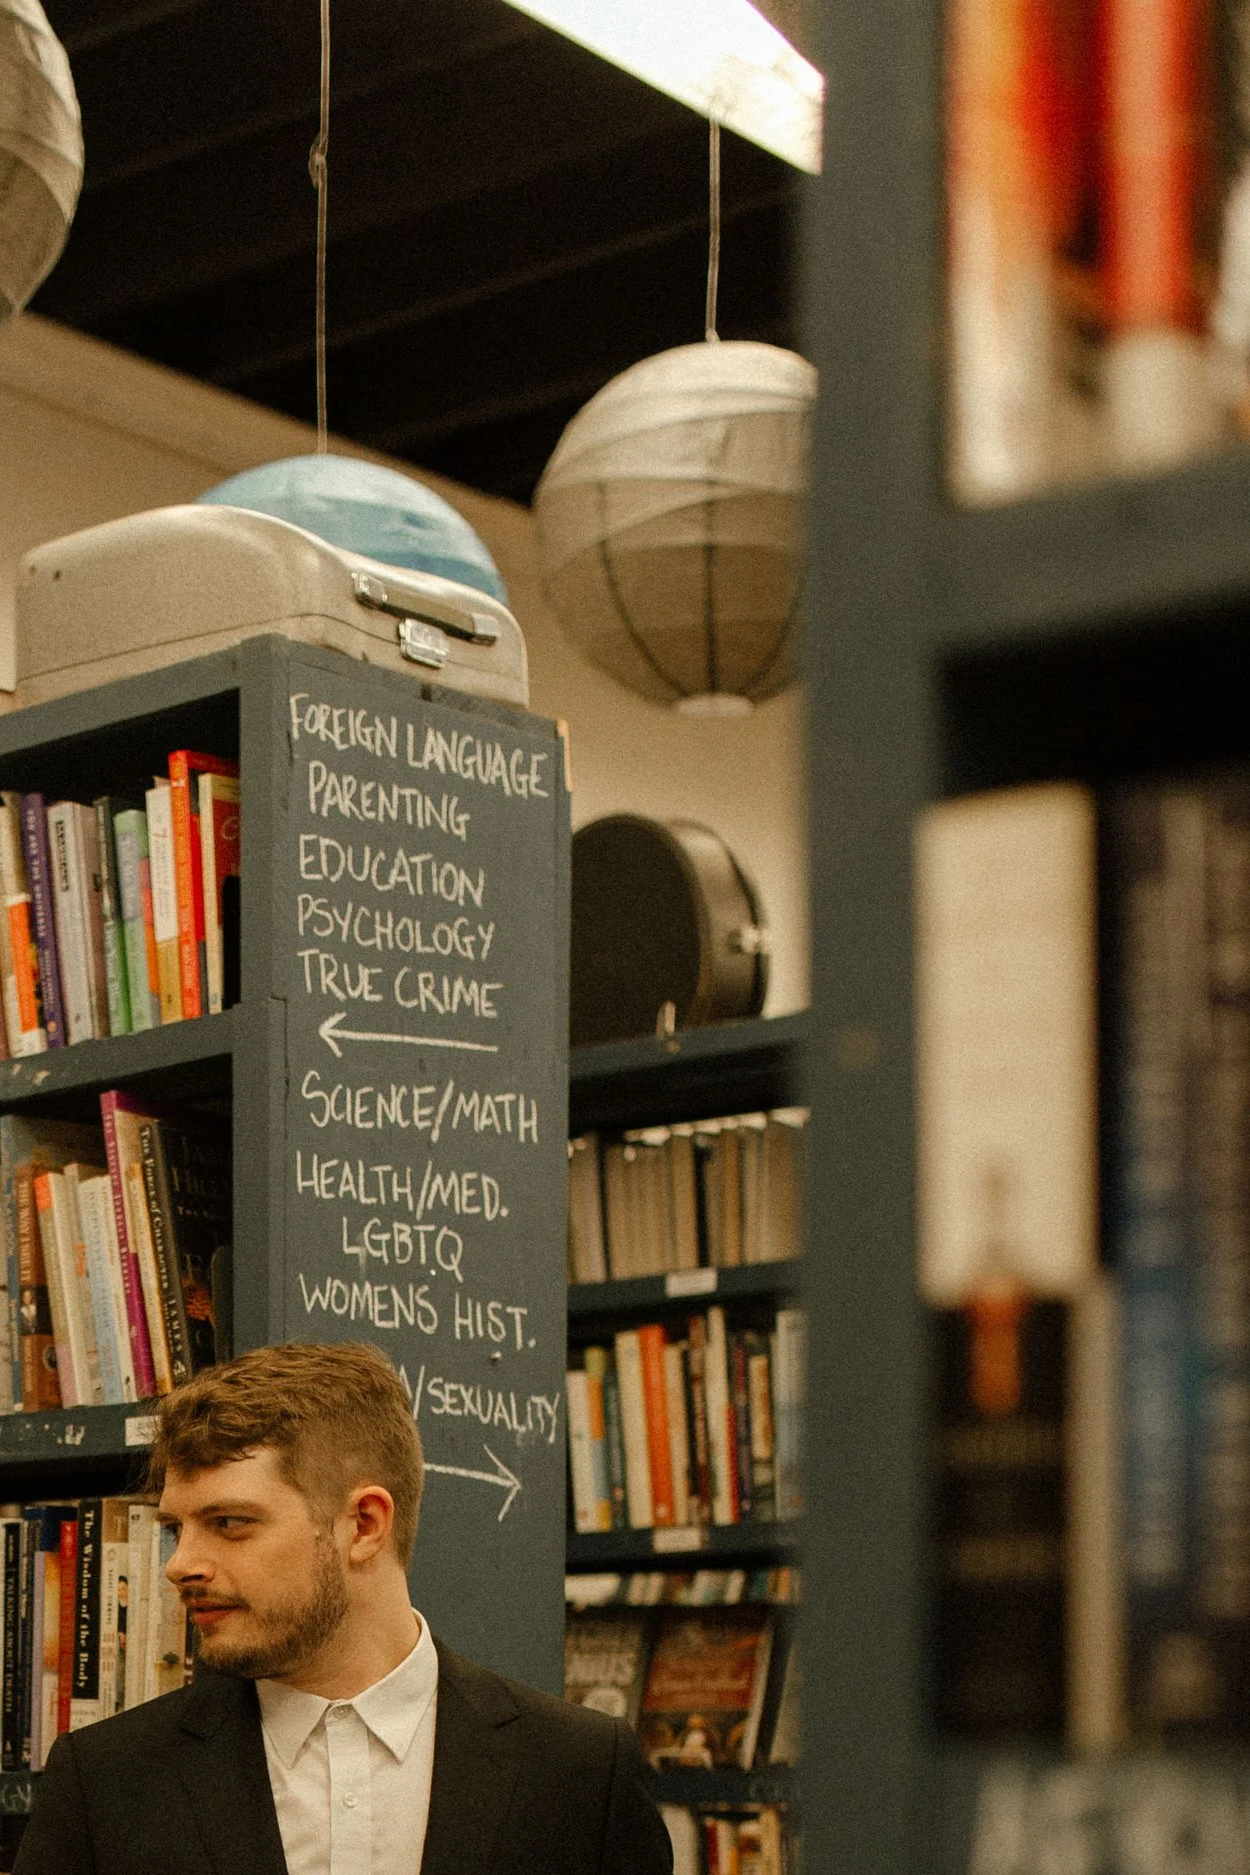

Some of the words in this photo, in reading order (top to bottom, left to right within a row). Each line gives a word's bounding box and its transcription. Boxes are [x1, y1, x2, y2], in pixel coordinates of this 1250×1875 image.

[289, 693, 398, 758] FOREIGN
[406, 723, 549, 798] LANGUAGE
[25, 809, 35, 830] YOU
[308, 761, 471, 841] PARENTING
[28, 834, 38, 855] ARE
[31, 859, 40, 879] THE
[299, 834, 485, 907] EDUCATION
[32, 884, 46, 937] UNIVERSE
[297, 894, 495, 961] PSYCHOLOGY
[297, 949, 383, 1001] TRUE
[394, 967, 504, 1018] CRIME
[302, 1070, 538, 1143] SCIENCE/MATH
[139, 1127, 153, 1155] THE
[18, 1181, 28, 1206] THE
[143, 1157, 158, 1197] FORCE
[19, 1208, 29, 1235] WAY
[149, 1199, 161, 1215] of
[20, 1242, 29, 1265] SEE
[152, 1216, 172, 1289] CHARACTER
[342, 1217, 463, 1282] LGBTQ
[20, 1268, 29, 1280] IT
[168, 1297, 184, 1352] JAMES
[299, 1273, 438, 1334] WOMENS
[454, 1297, 537, 1349] HIST.
[84, 1510, 93, 1538] The
[81, 1543, 92, 1599] Wisdom
[5, 1576, 15, 1626] TALKING
[80, 1604, 89, 1619] of
[4, 1630, 14, 1669] ABOUT
[79, 1623, 88, 1646] the
[76, 1652, 87, 1688] Body
[3, 1673, 13, 1713] DEATH
